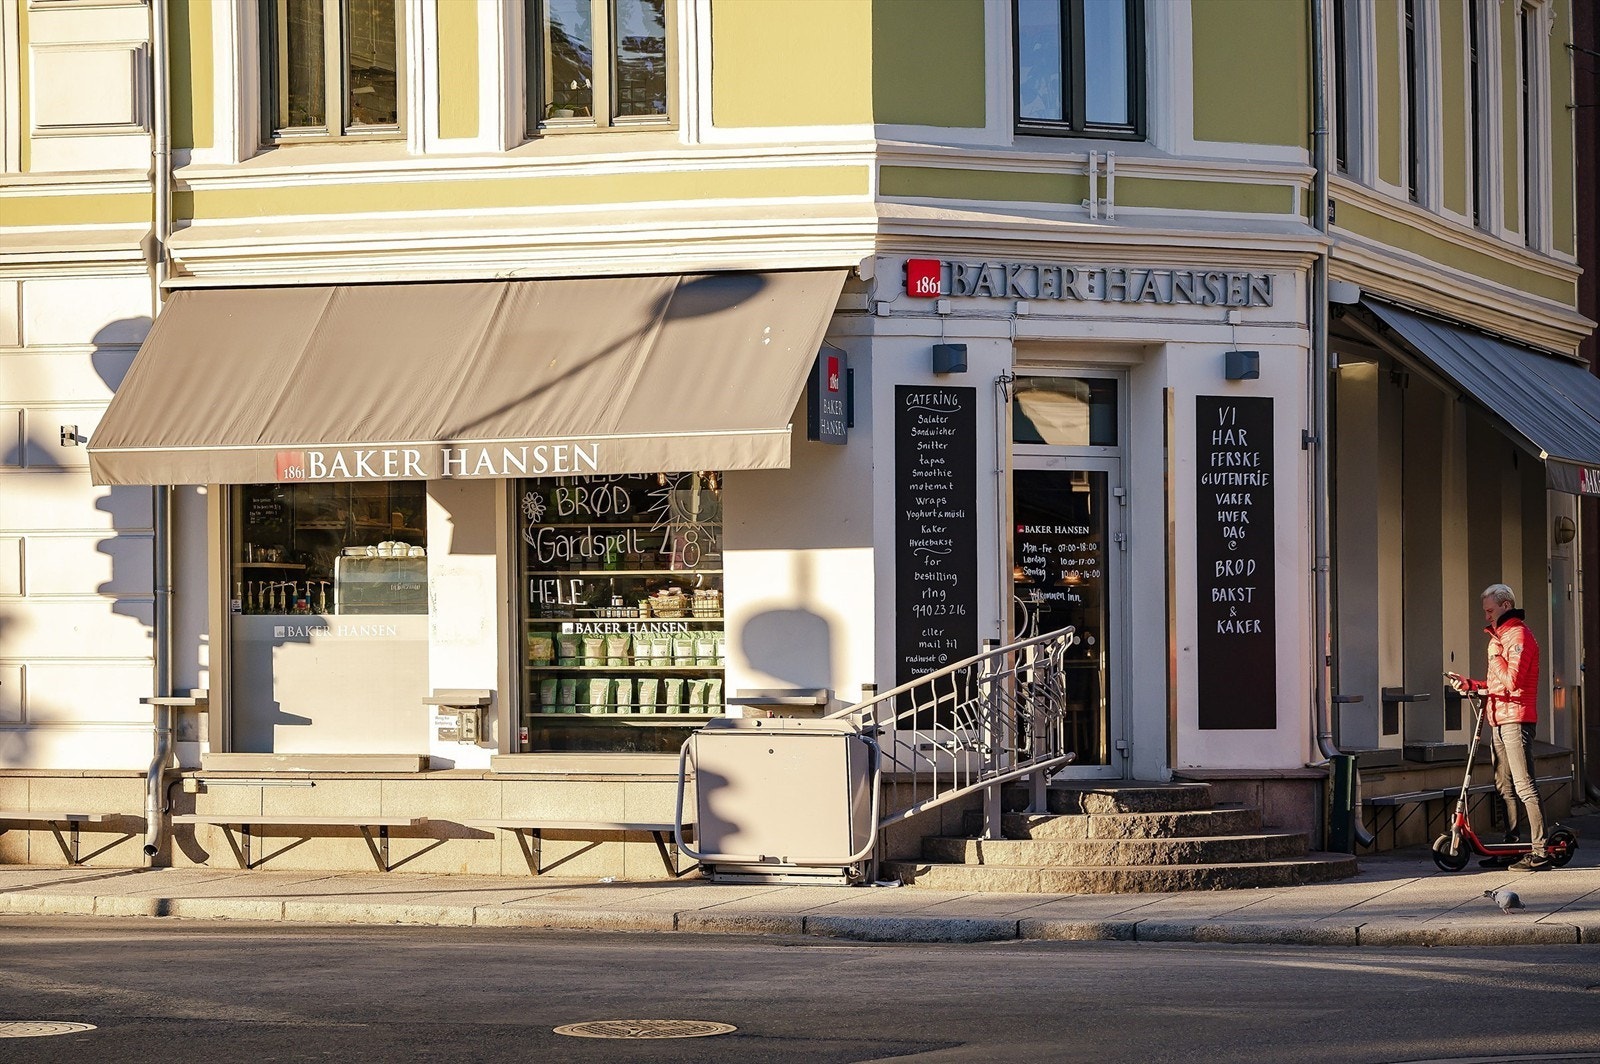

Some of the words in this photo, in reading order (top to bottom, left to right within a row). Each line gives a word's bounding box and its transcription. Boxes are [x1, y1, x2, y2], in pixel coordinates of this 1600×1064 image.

[915, 276, 941, 294] 1861
[949, 261, 1085, 300] BAKER
[1101, 268, 1277, 308] HANSEN
[905, 390, 959, 406] CATERING
[823, 398, 843, 415] BAKER
[917, 414, 949, 424] Salater
[1218, 406, 1236, 426] VI
[820, 419, 846, 436] HANSEN
[910, 426, 957, 437] Sandwicher
[1212, 429, 1248, 446] HAR
[916, 441, 949, 450] Snitter
[283, 465, 306, 480] 1861
[307, 448, 428, 479] BAKER
[441, 443, 601, 477] HANSEN
[918, 453, 946, 467] tapas
[1211, 451, 1261, 467] FERSKE
[912, 468, 953, 478] Smoothie
[1201, 470, 1270, 487] GLUTENFRIE
[556, 483, 631, 517] BRØD
[1215, 492, 1253, 505] VARER
[1217, 510, 1250, 524] HVER
[1025, 525, 1052, 534] BAKER
[1054, 525, 1089, 535] HANSEN
[1223, 526, 1246, 539] DAG
[537, 526, 646, 564] Gardspelt
[924, 554, 942, 566] for
[1215, 558, 1256, 578] BRØD
[914, 572, 958, 587] bestilling
[529, 578, 589, 606] HELE
[921, 587, 946, 602] ring
[1211, 586, 1257, 603] BAKST
[1229, 605, 1238, 617] &
[287, 625, 333, 638] BAKER
[337, 625, 398, 638] HANSEN
[575, 622, 622, 635] BAKER
[626, 622, 689, 635] HANSEN
[921, 628, 945, 637] eller
[1217, 619, 1262, 634] KAKER
[918, 639, 941, 649] mail
[946, 638, 958, 650] til
